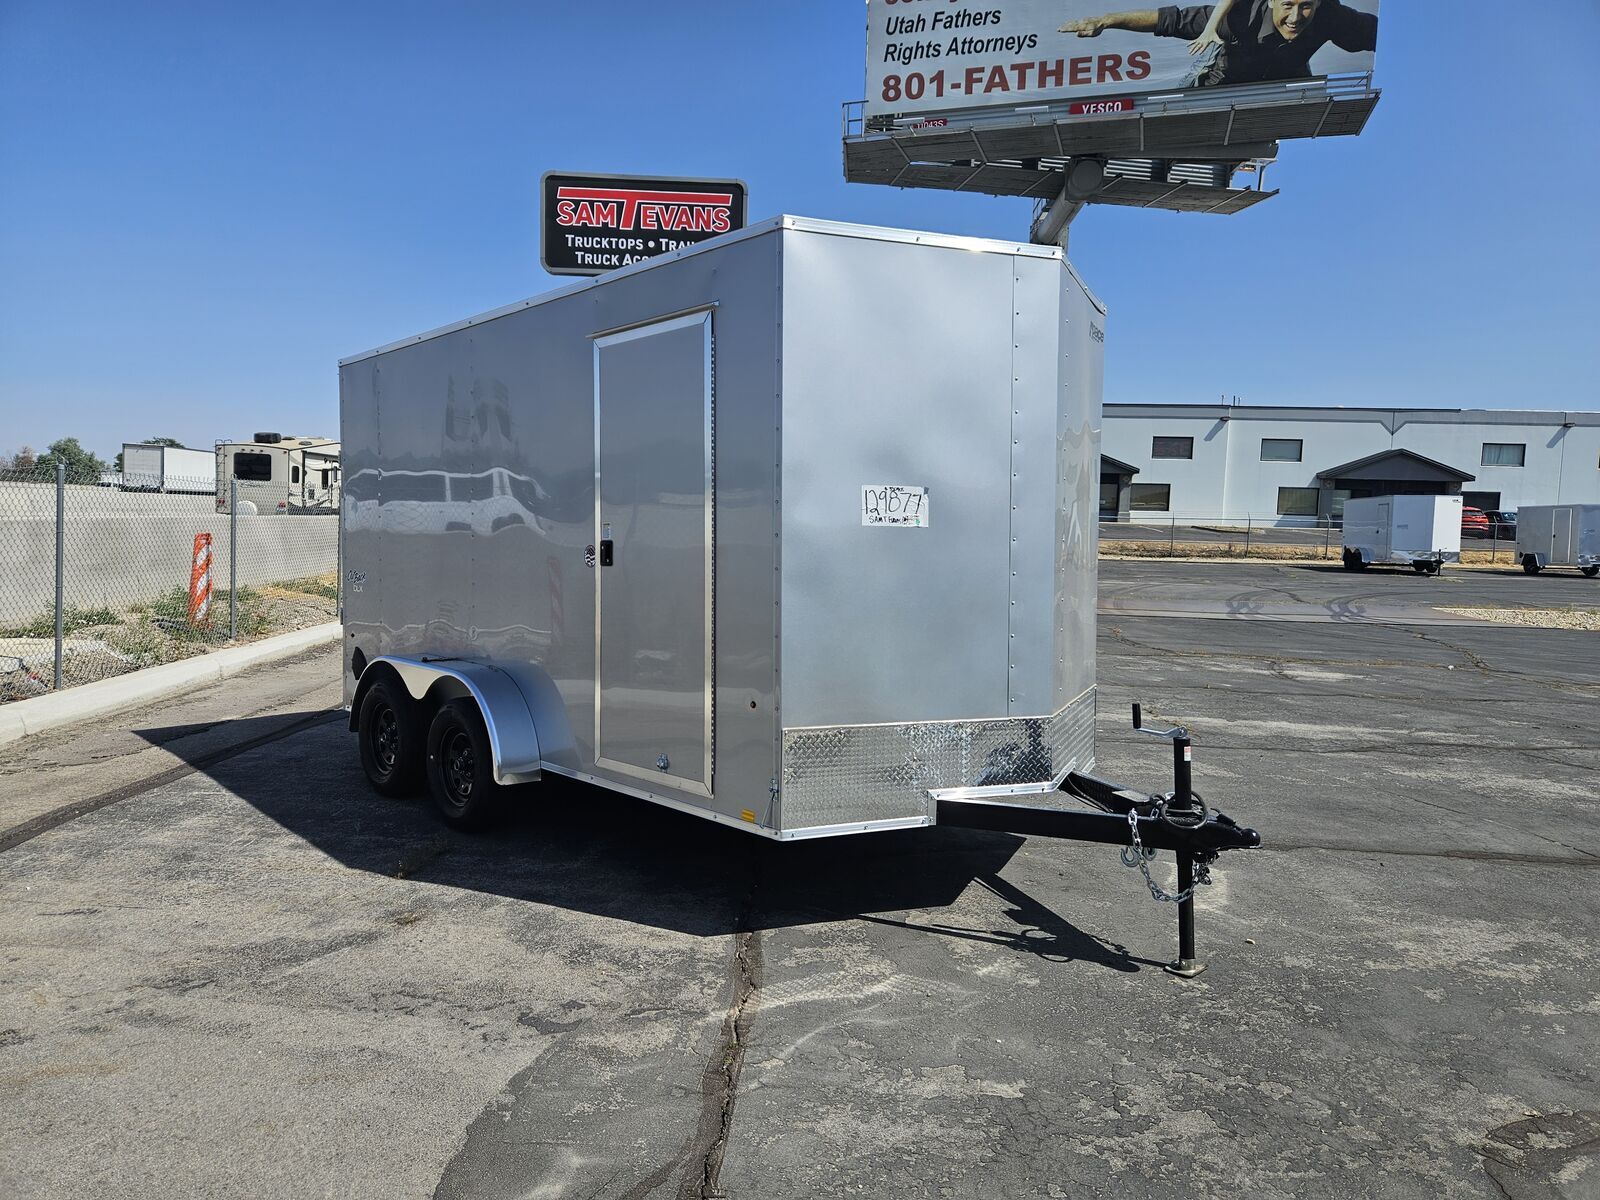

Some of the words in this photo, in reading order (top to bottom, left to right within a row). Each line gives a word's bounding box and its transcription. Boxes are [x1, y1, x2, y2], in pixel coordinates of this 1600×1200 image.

[885, 13, 926, 36] Utah
[931, 8, 1002, 31] Fathers
[883, 40, 942, 66] Rights
[945, 32, 1038, 57] Attorneys
[881, 50, 1152, 103] 801-FATHERS
[1081, 101, 1122, 115] YESCO
[556, 200, 617, 228] SAM
[640, 203, 731, 233] EVANS
[864, 489, 922, 516] 129877
